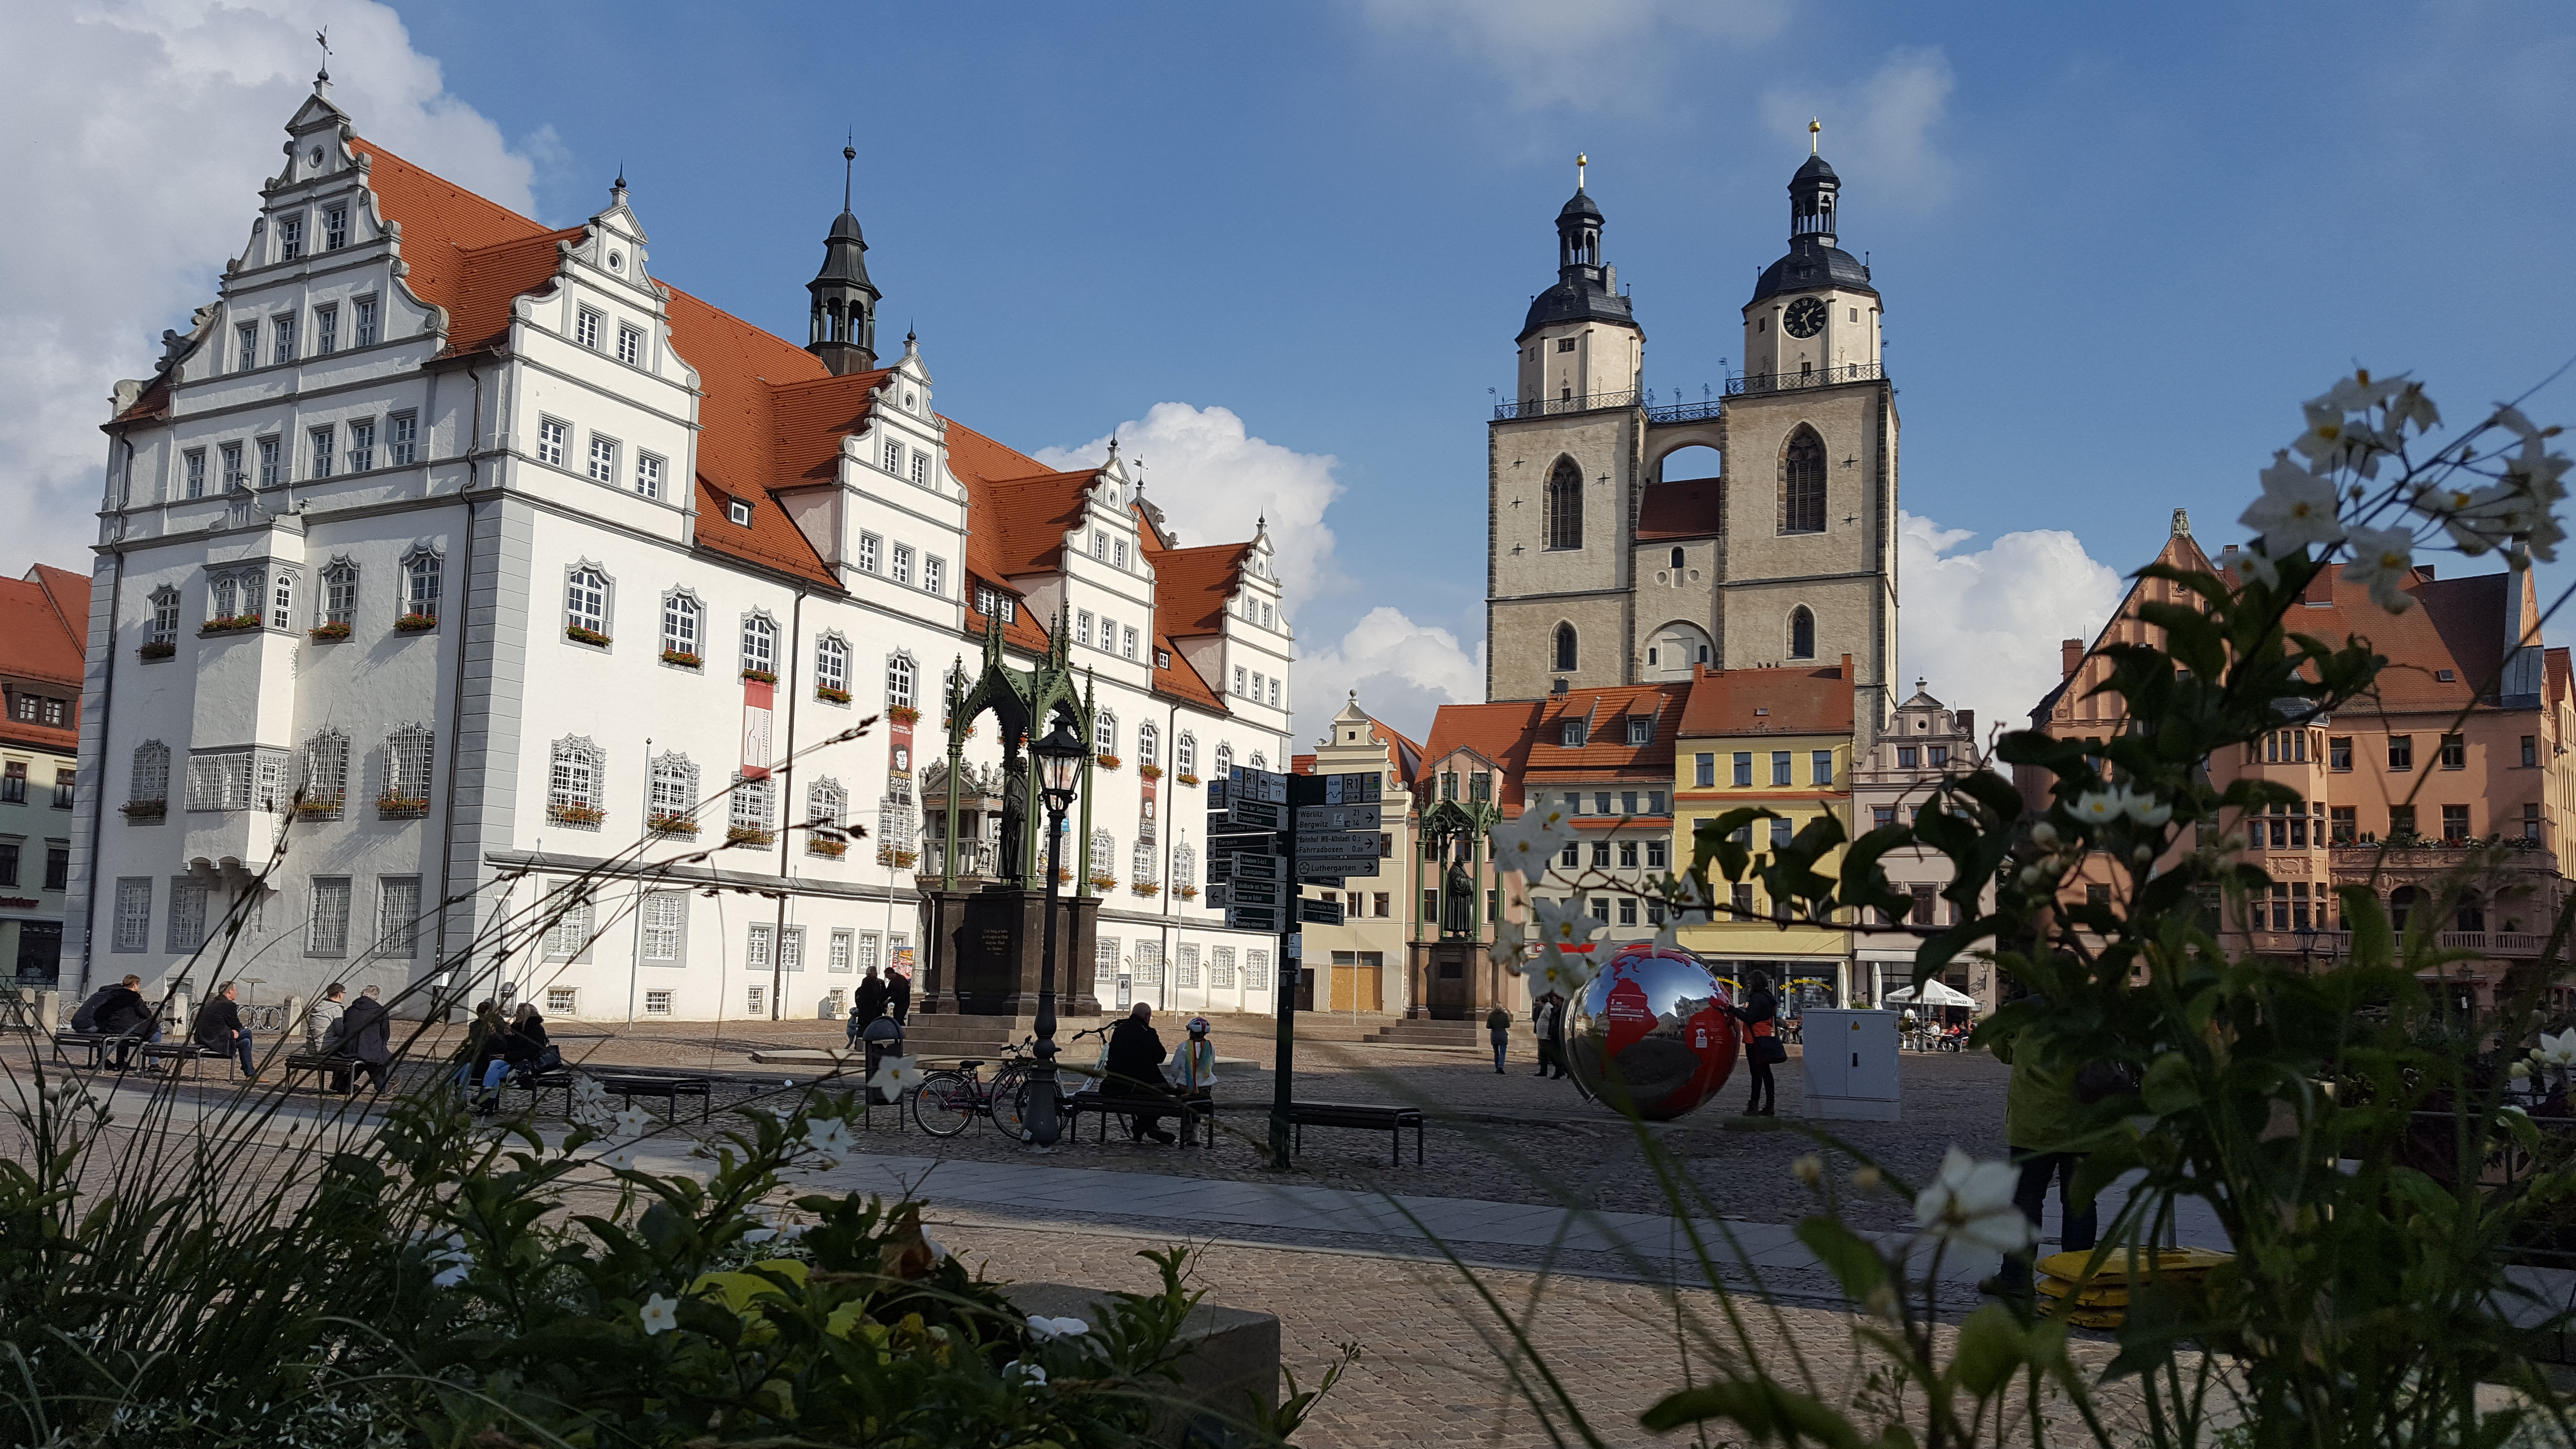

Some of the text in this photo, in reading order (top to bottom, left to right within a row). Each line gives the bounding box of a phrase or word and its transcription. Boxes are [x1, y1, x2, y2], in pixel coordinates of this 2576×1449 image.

[890, 770, 911, 779] LUTHER
[1246, 773, 1255, 785] R1
[890, 777, 911, 791] 2017
[1346, 778, 1358, 789] R1
[1257, 806, 1276, 815] Geschichte
[1141, 823, 1155, 834] 2017
[1311, 864, 1356, 872] Luthergarten
